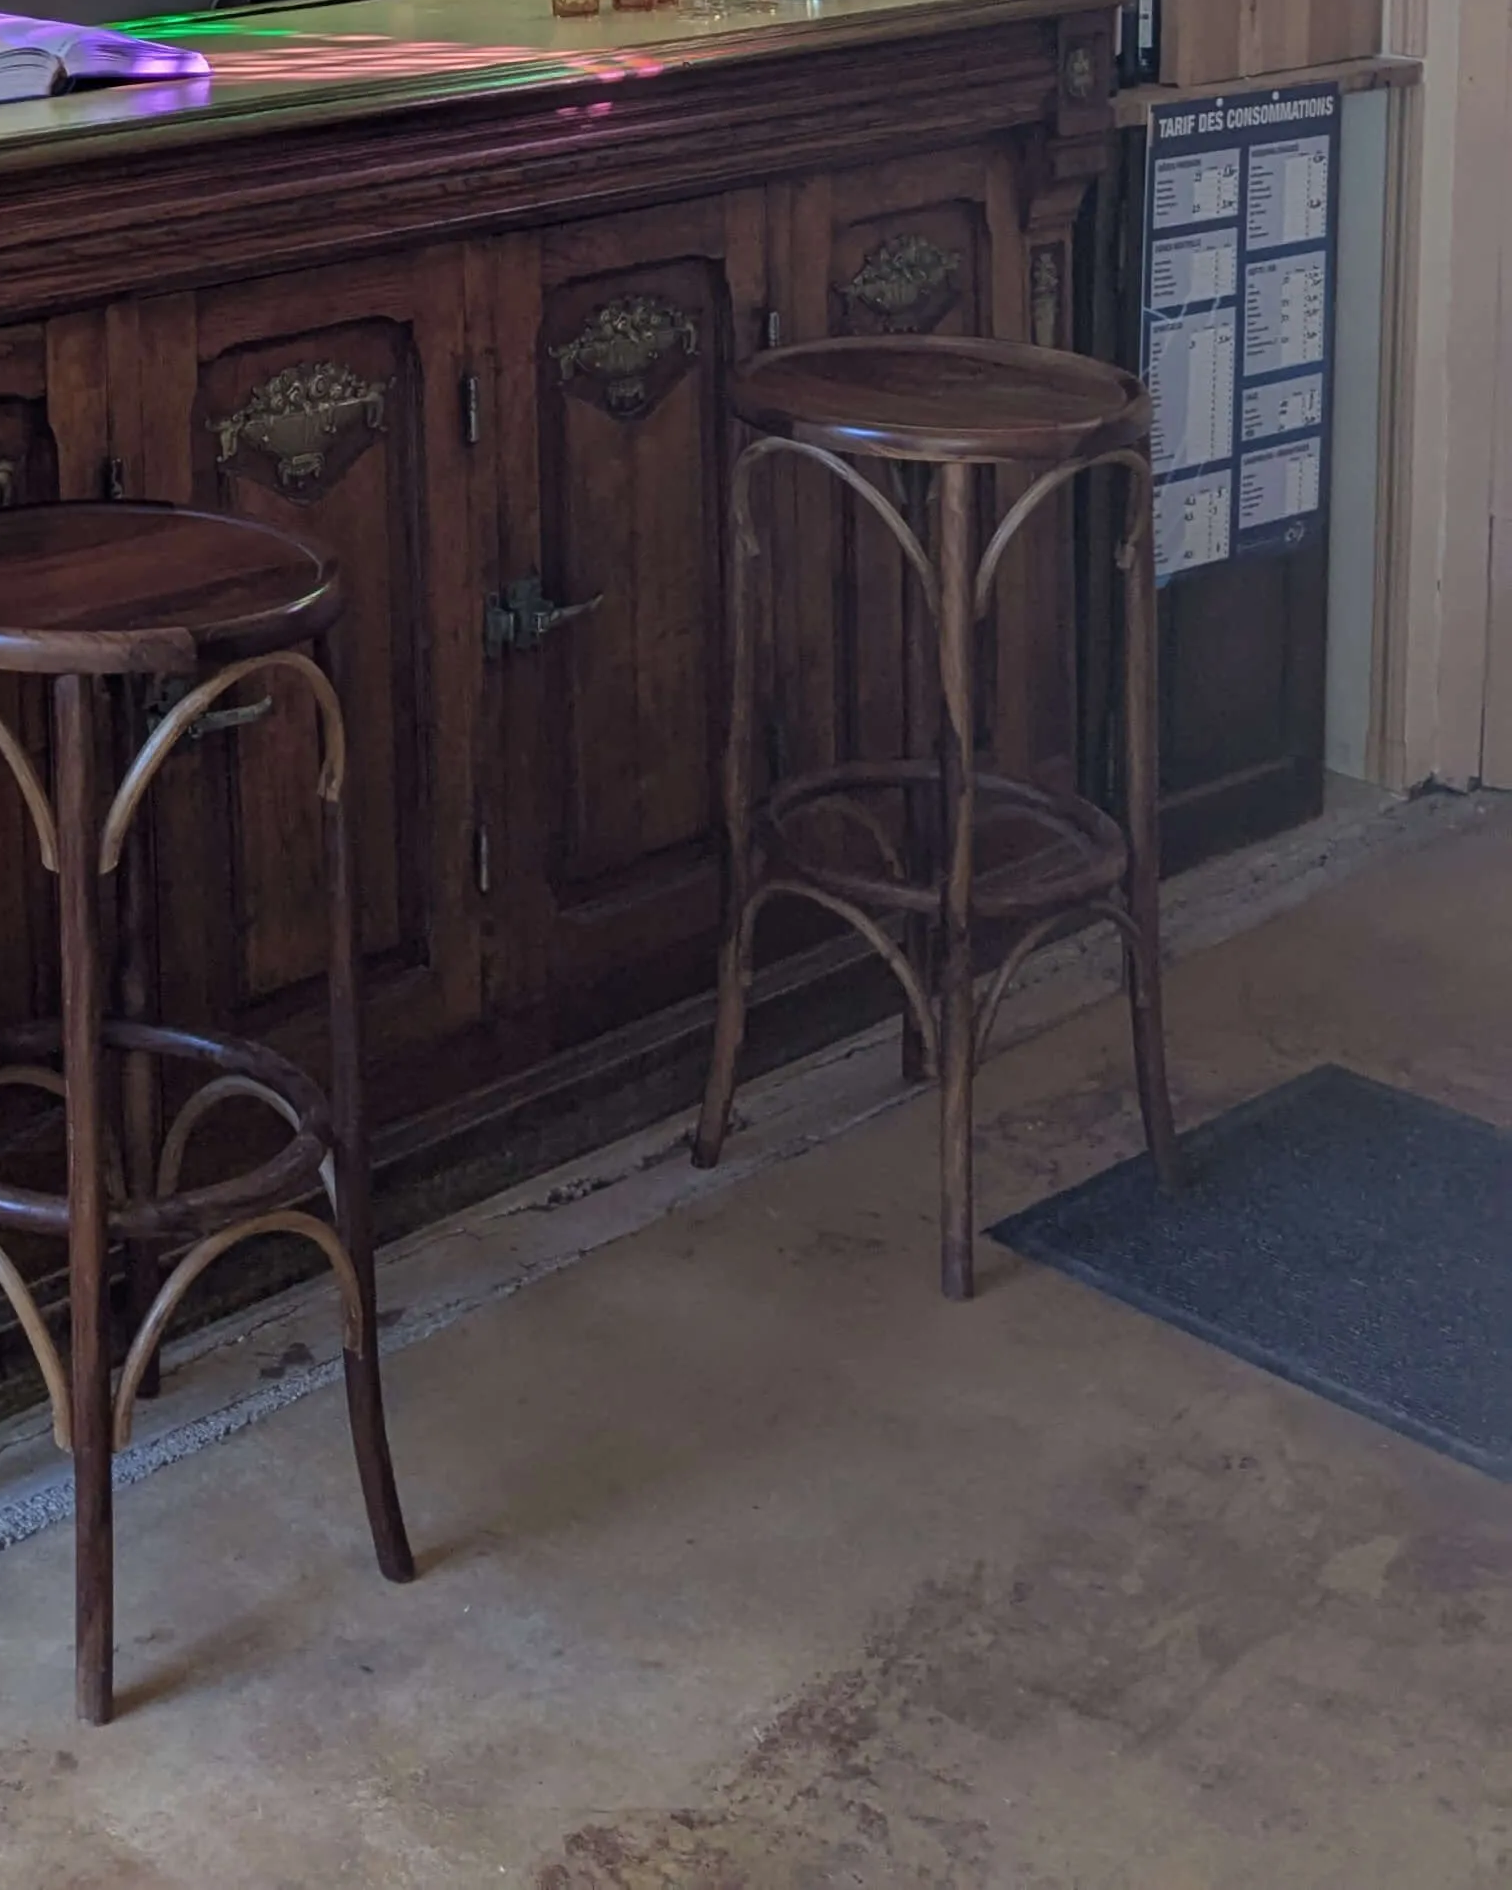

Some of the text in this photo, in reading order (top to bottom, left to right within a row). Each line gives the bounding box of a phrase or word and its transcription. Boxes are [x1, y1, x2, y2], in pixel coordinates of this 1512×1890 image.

[1159, 95, 1334, 139] TARIF DES CONSOMMATIONS
